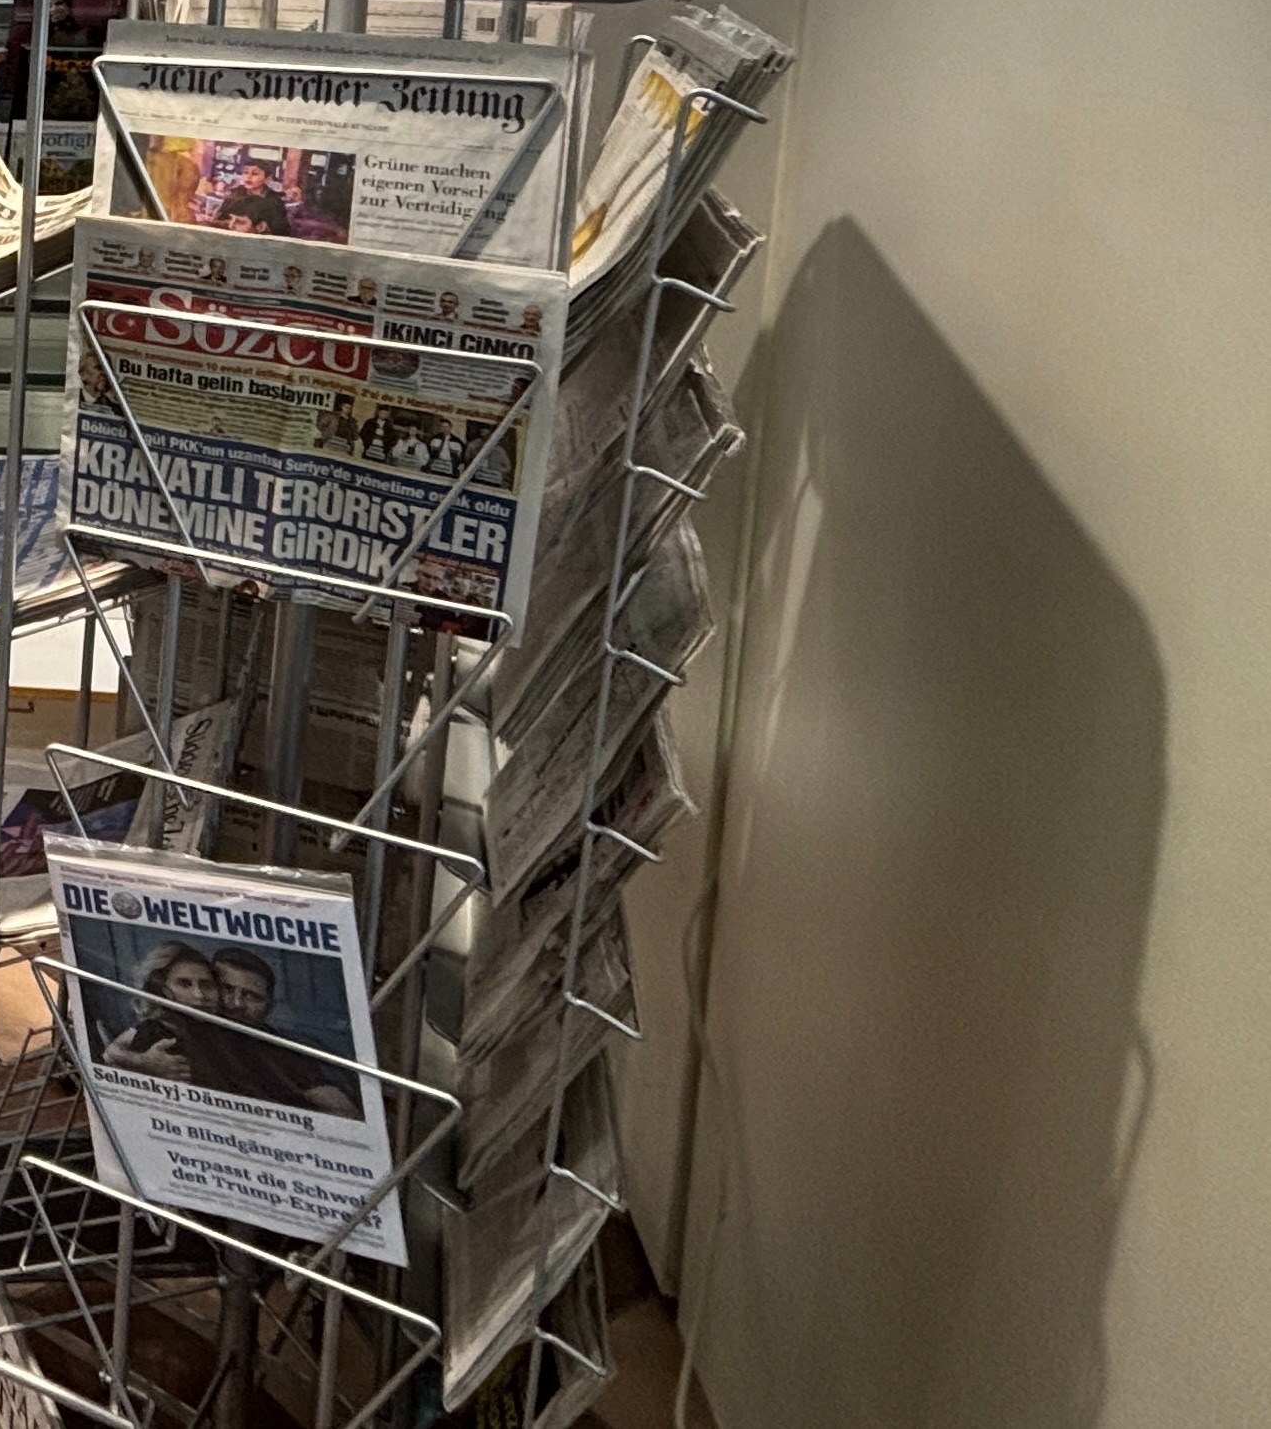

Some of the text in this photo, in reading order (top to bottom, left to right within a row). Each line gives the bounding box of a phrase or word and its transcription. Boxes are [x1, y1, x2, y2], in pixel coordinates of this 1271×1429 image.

[376, 80, 526, 133] Zeitung
[364, 153, 491, 181] Grüne machen
[361, 175, 425, 194] eigenen
[359, 195, 508, 225] zur Verteidigng
[119, 358, 143, 376] Bu
[147, 363, 193, 385] hafta
[197, 374, 244, 394] gelin
[474, 500, 511, 518] oldu
[63, 882, 112, 916] DIE
[142, 895, 341, 952] WELTWOCHE
[93, 1066, 316, 1132] Selenskyj-Dämmerung
[149, 1116, 182, 1137] Die
[166, 1150, 379, 1213] Verpasst die Schwei
[171, 1166, 208, 1186] den
